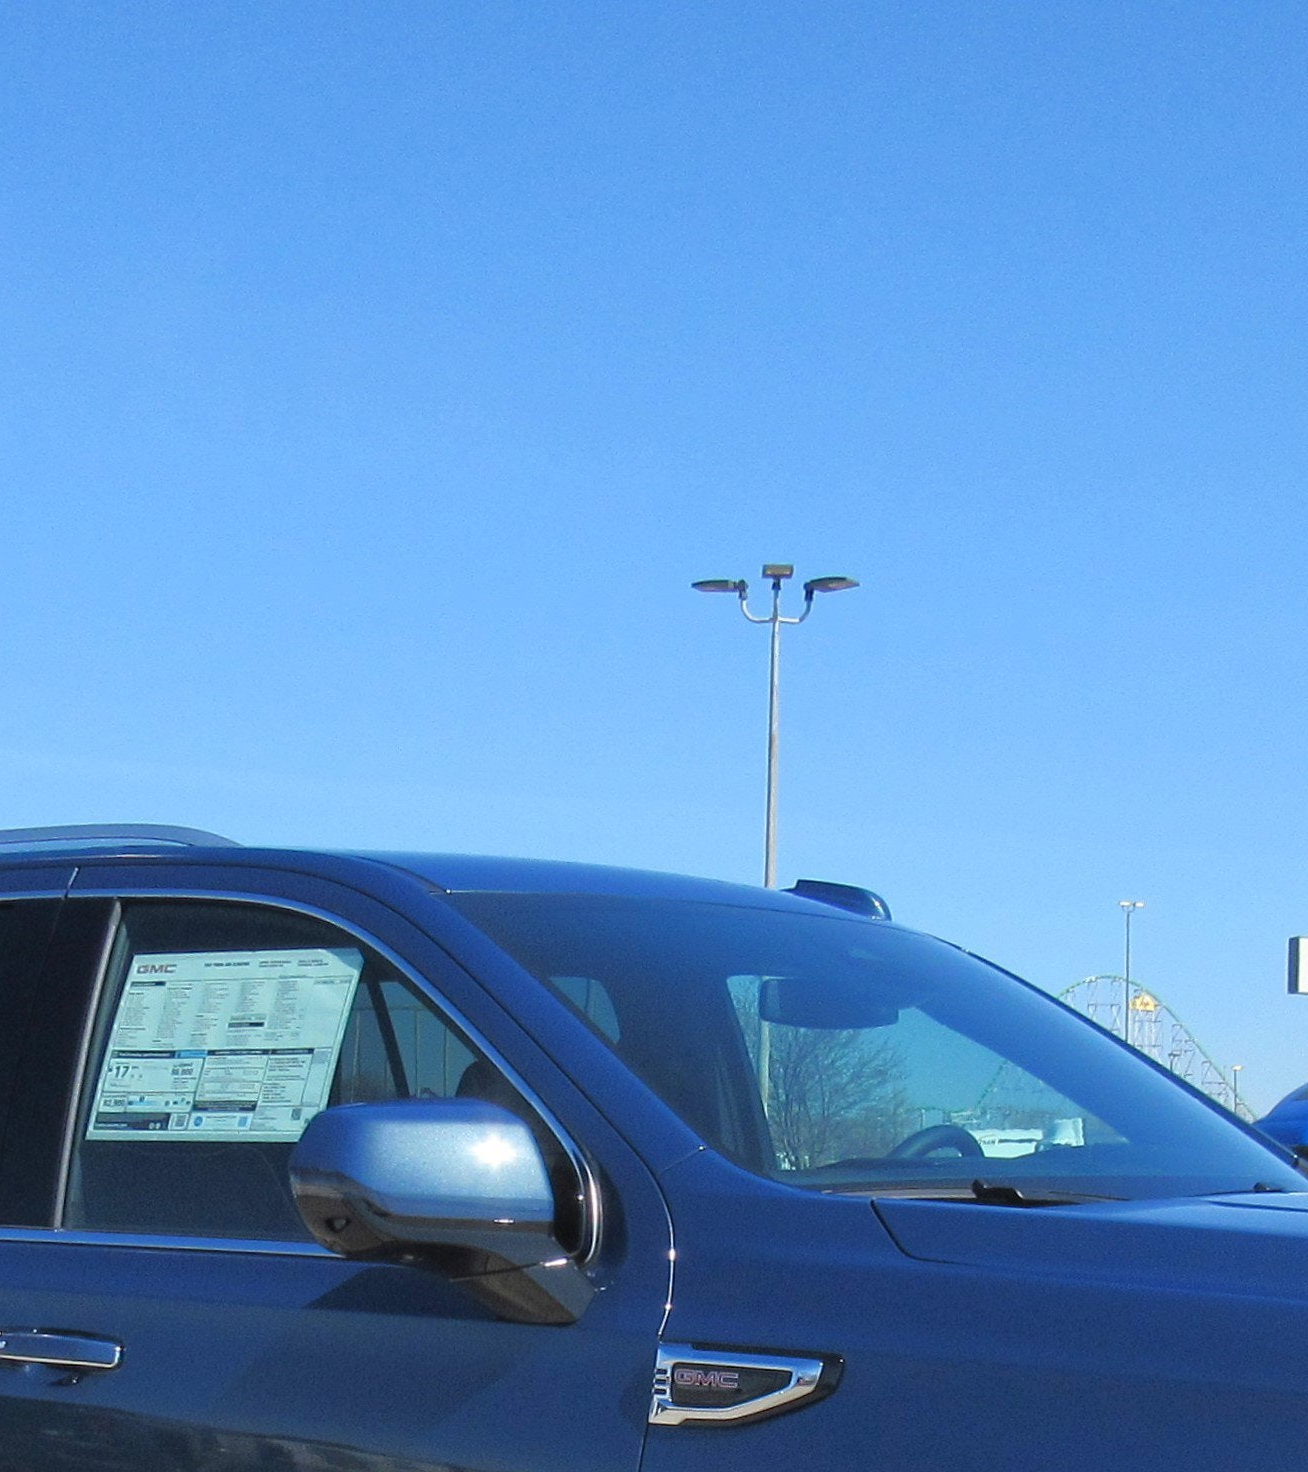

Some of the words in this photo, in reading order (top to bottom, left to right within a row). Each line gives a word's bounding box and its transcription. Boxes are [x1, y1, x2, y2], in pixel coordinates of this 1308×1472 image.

[136, 964, 177, 974] GMC
[115, 1066, 130, 1078] 17
[674, 1368, 740, 1389] GMC
